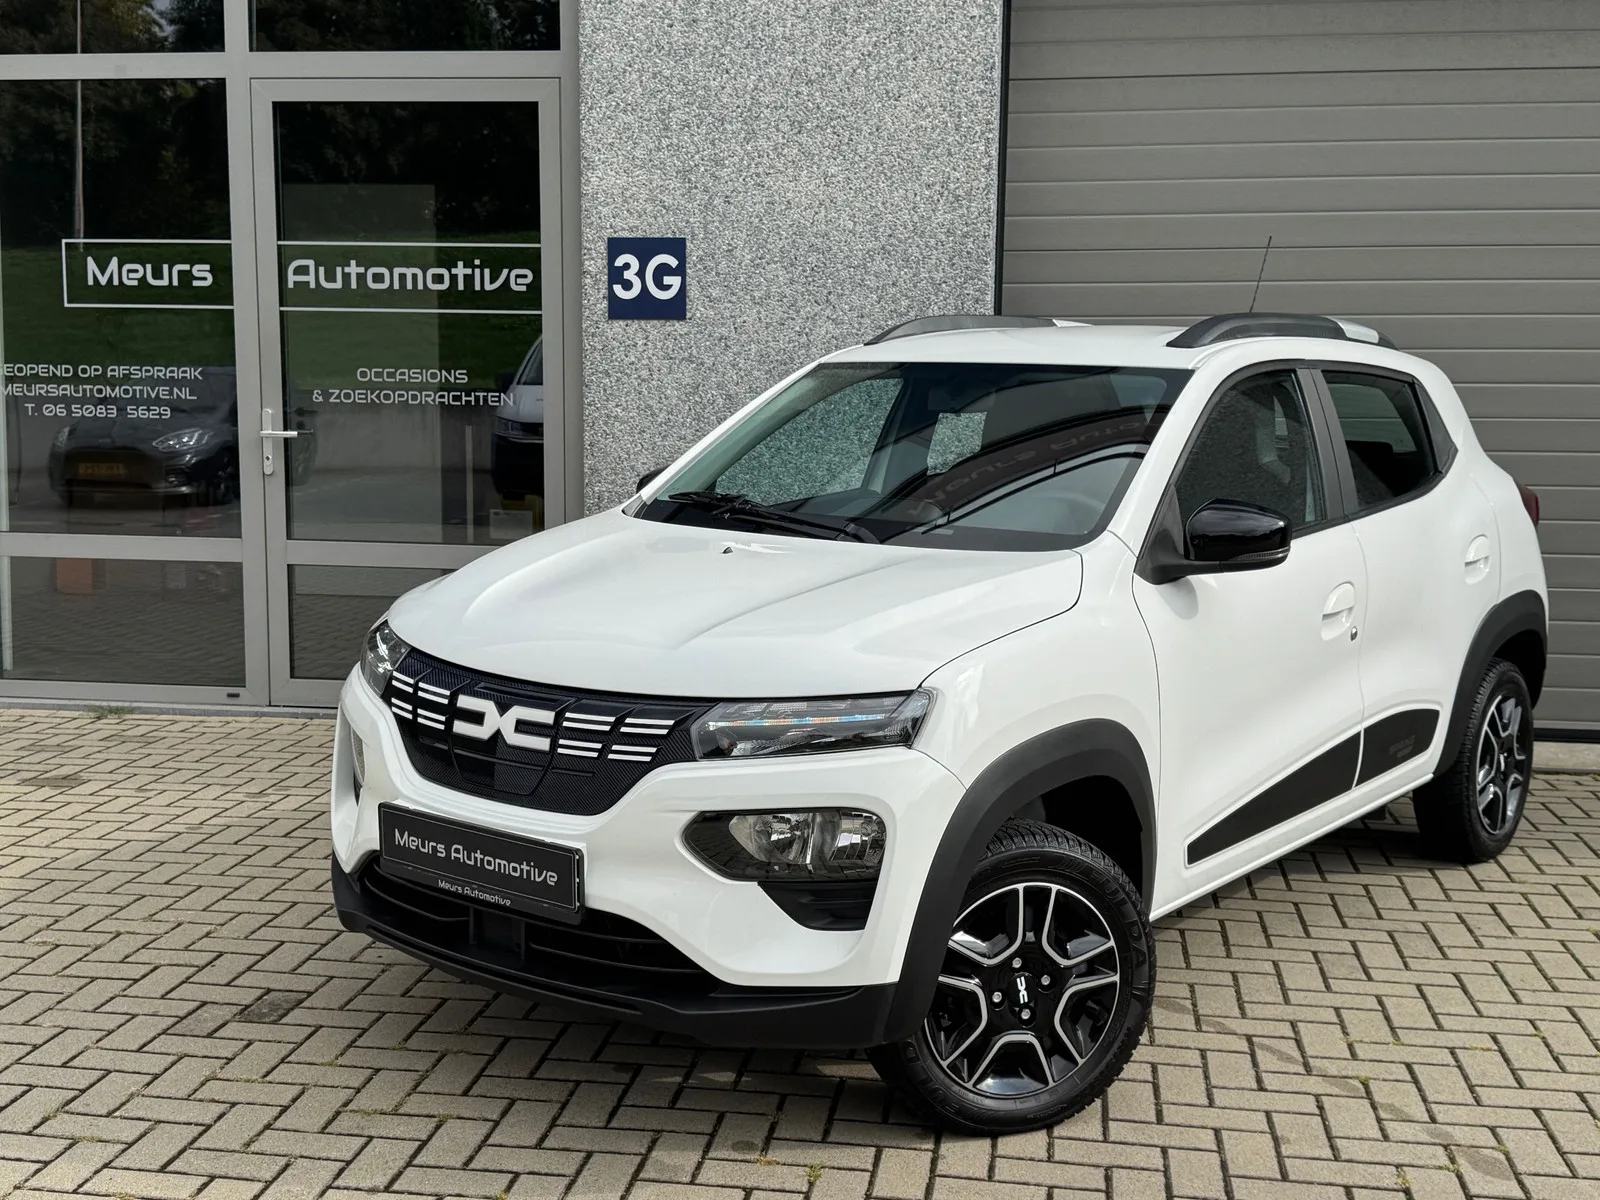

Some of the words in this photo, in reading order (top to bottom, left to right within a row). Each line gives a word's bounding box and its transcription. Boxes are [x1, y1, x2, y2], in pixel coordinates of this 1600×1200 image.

[86, 256, 213, 287] Meurs
[287, 259, 533, 292] Automotive
[613, 253, 682, 300] 3G
[78, 365, 102, 378] OP
[107, 365, 203, 380] AFSPRAAK
[356, 368, 468, 383] OCCASIONS
[312, 389, 324, 402] &
[329, 389, 514, 406] ZOEKOPDRACHTEN
[24, 403, 38, 416] T.
[42, 404, 67, 417] 06
[71, 404, 117, 418] 5083
[127, 406, 171, 419] 5629
[394, 828, 446, 858] Meurs
[451, 844, 558, 886] Automotive
[438, 879, 463, 894] Meurs
[464, 886, 511, 907] Automotive
